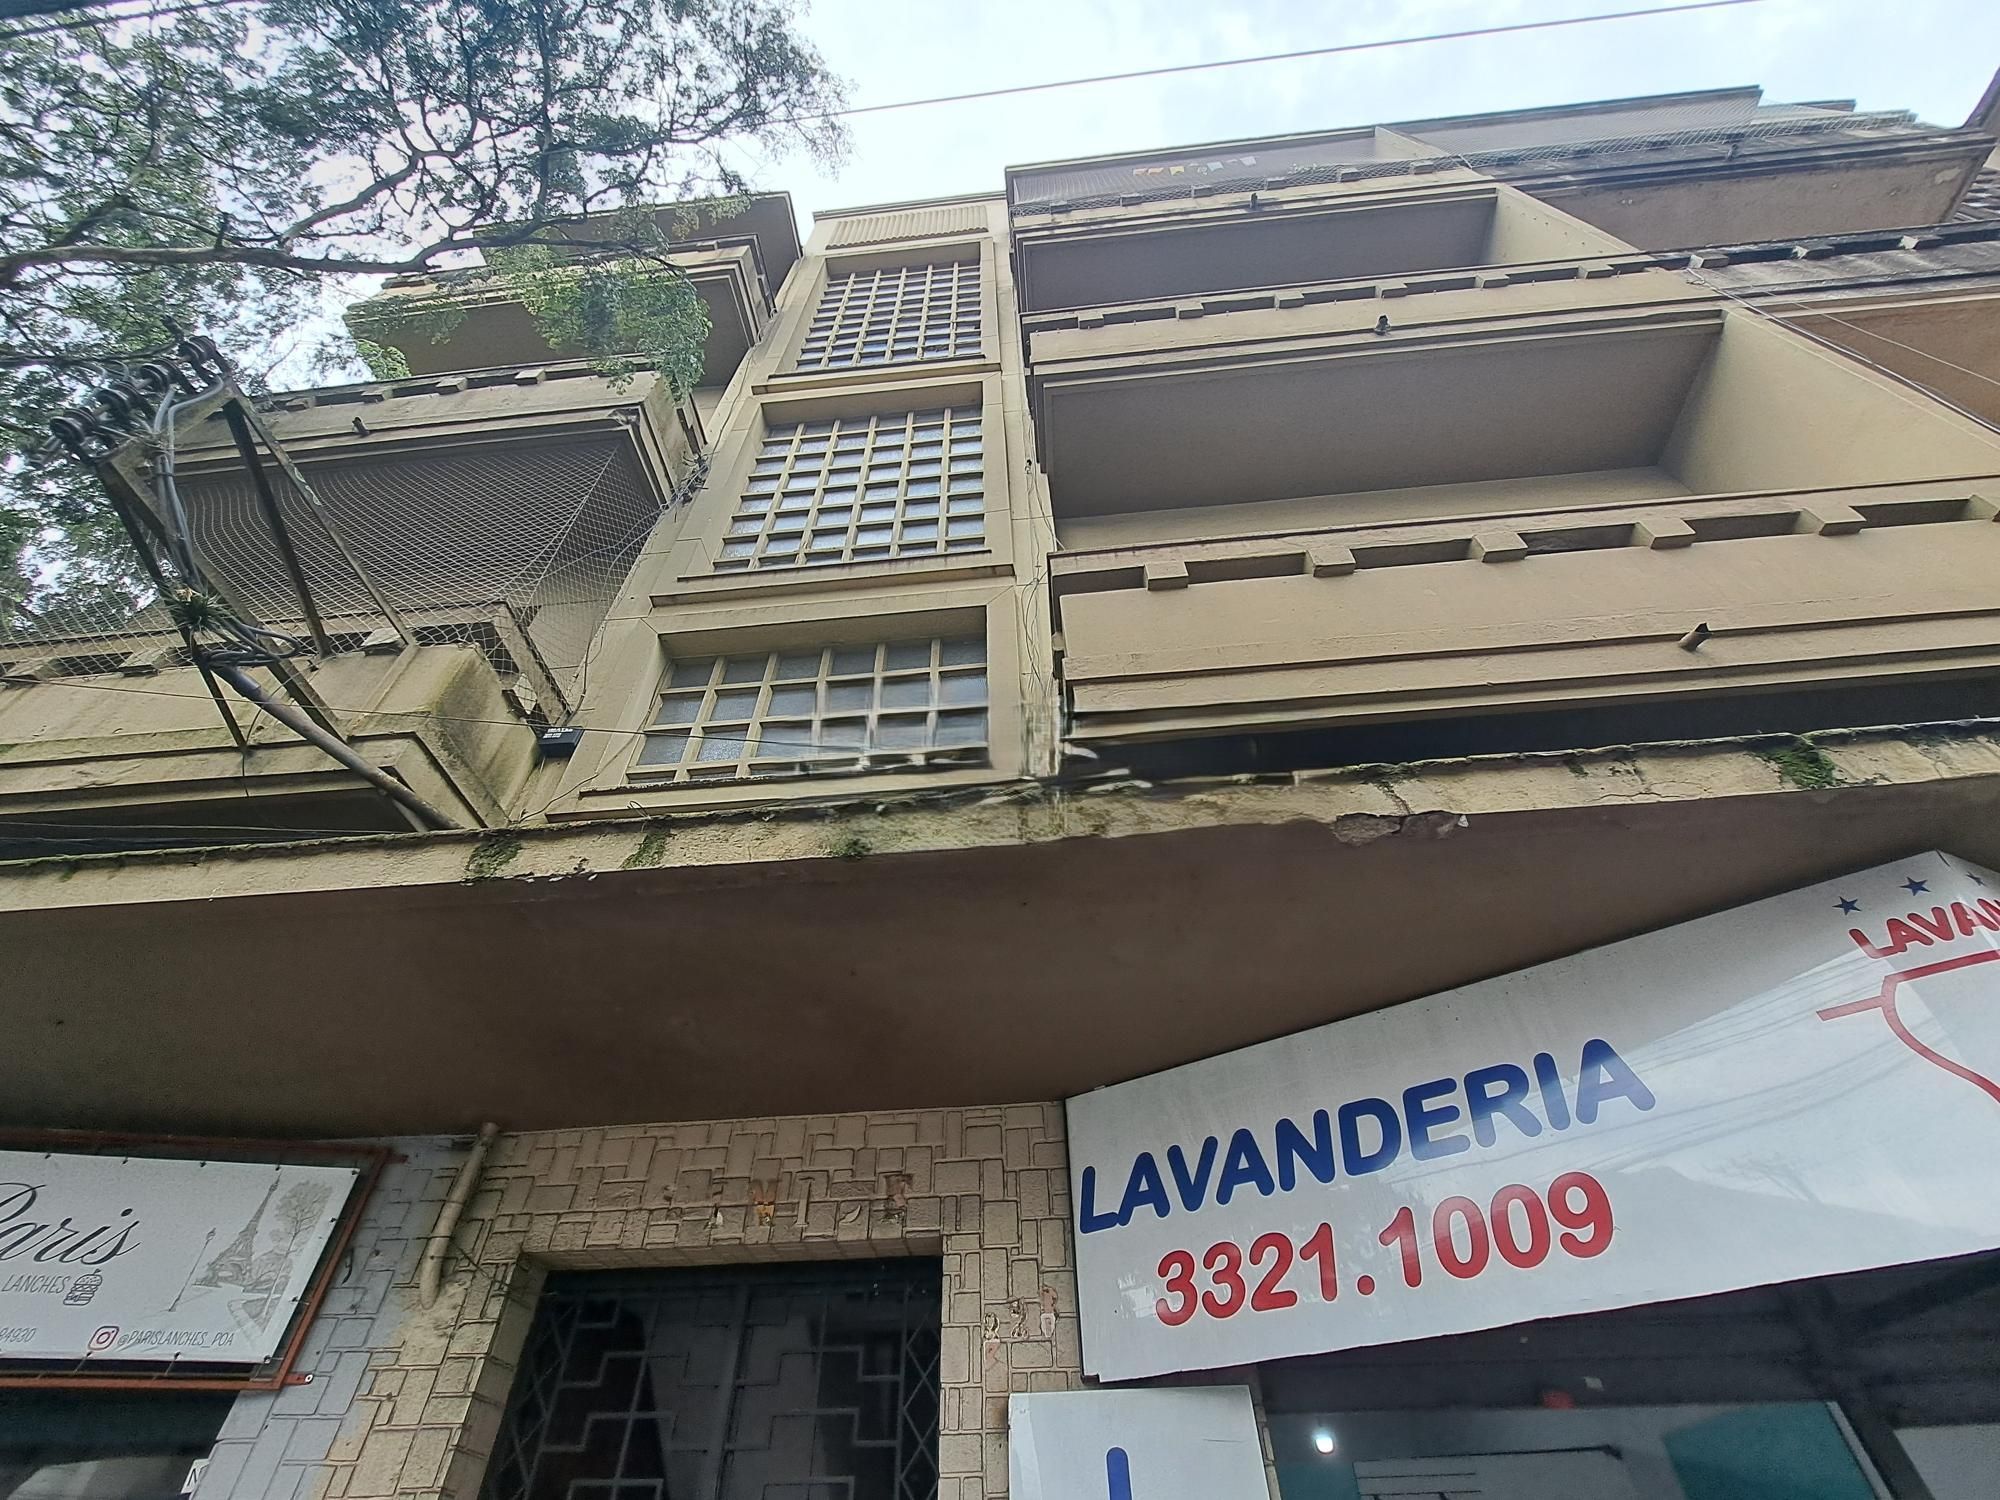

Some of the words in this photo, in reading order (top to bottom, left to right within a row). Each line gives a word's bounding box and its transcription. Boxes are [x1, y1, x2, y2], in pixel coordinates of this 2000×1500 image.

[1079, 1038, 1656, 1234] LAVANDERIA
[1, 1274, 71, 1294] LANCHES
[1156, 1171, 1614, 1326] 3321.1009
[117, 1330, 235, 1348] @PARISLANCHES_POA
